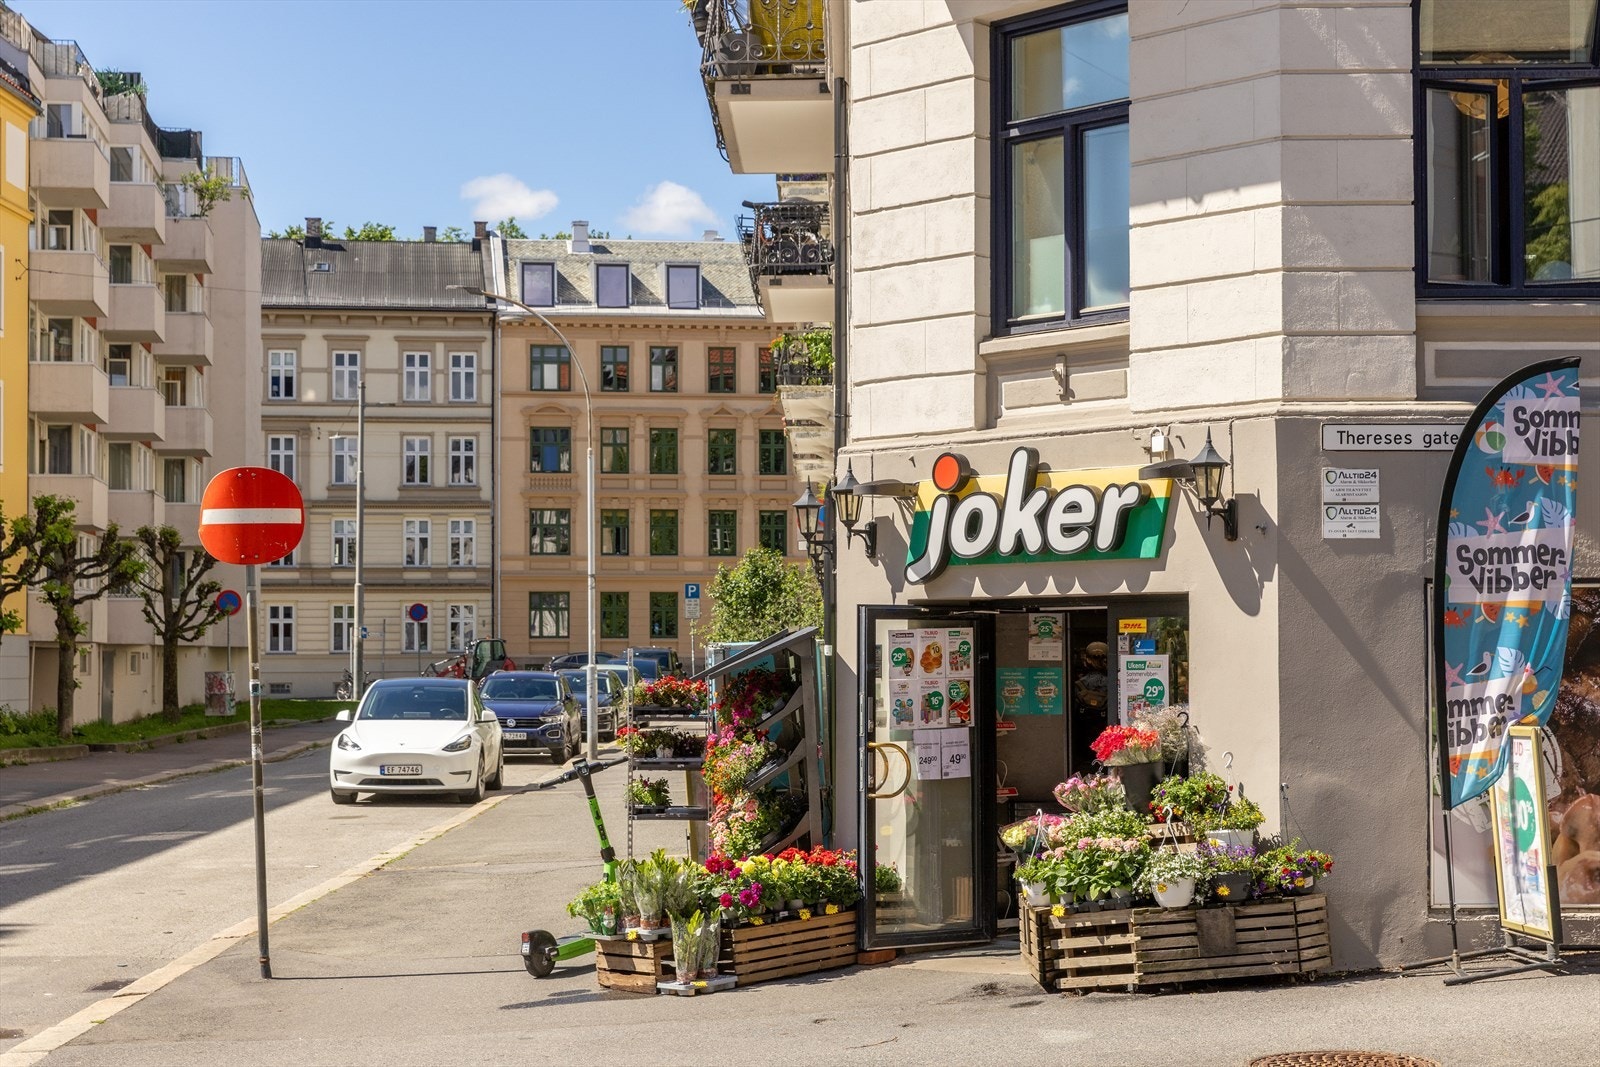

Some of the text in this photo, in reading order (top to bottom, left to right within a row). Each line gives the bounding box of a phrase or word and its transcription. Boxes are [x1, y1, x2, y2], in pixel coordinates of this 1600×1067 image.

[1336, 430, 1458, 448] Thereses gate
[904, 446, 1150, 585] joker
[688, 585, 696, 597] P
[1469, 565, 1557, 594] Vibber
